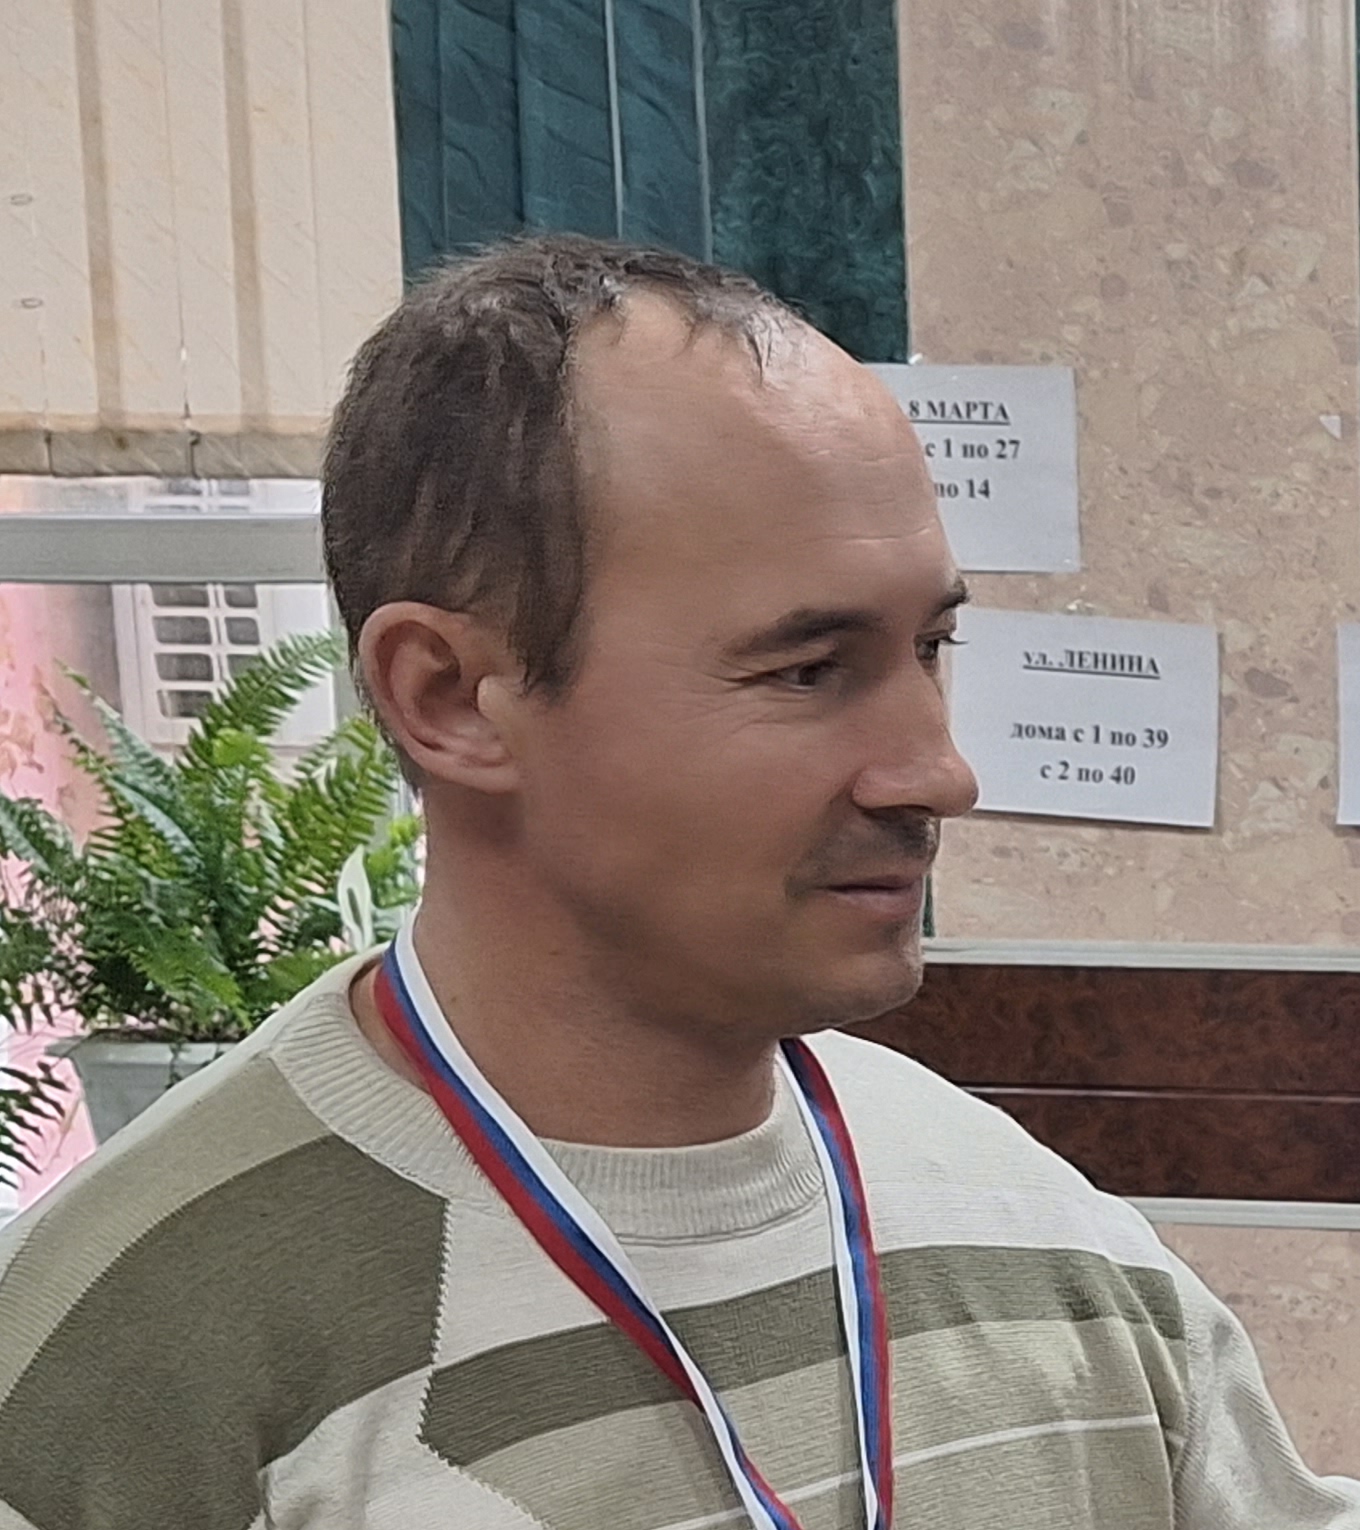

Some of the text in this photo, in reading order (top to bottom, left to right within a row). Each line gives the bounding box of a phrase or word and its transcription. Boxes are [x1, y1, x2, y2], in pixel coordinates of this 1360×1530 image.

[909, 400, 1011, 422] 8 МАРТА
[925, 438, 1021, 460] с 1 по 27
[966, 479, 990, 499] 14
[1022, 649, 1160, 676] ул. ЛЕНИНА
[1010, 723, 1169, 749] дома с 1 по 39
[1040, 760, 1136, 785] с 2 по 40
